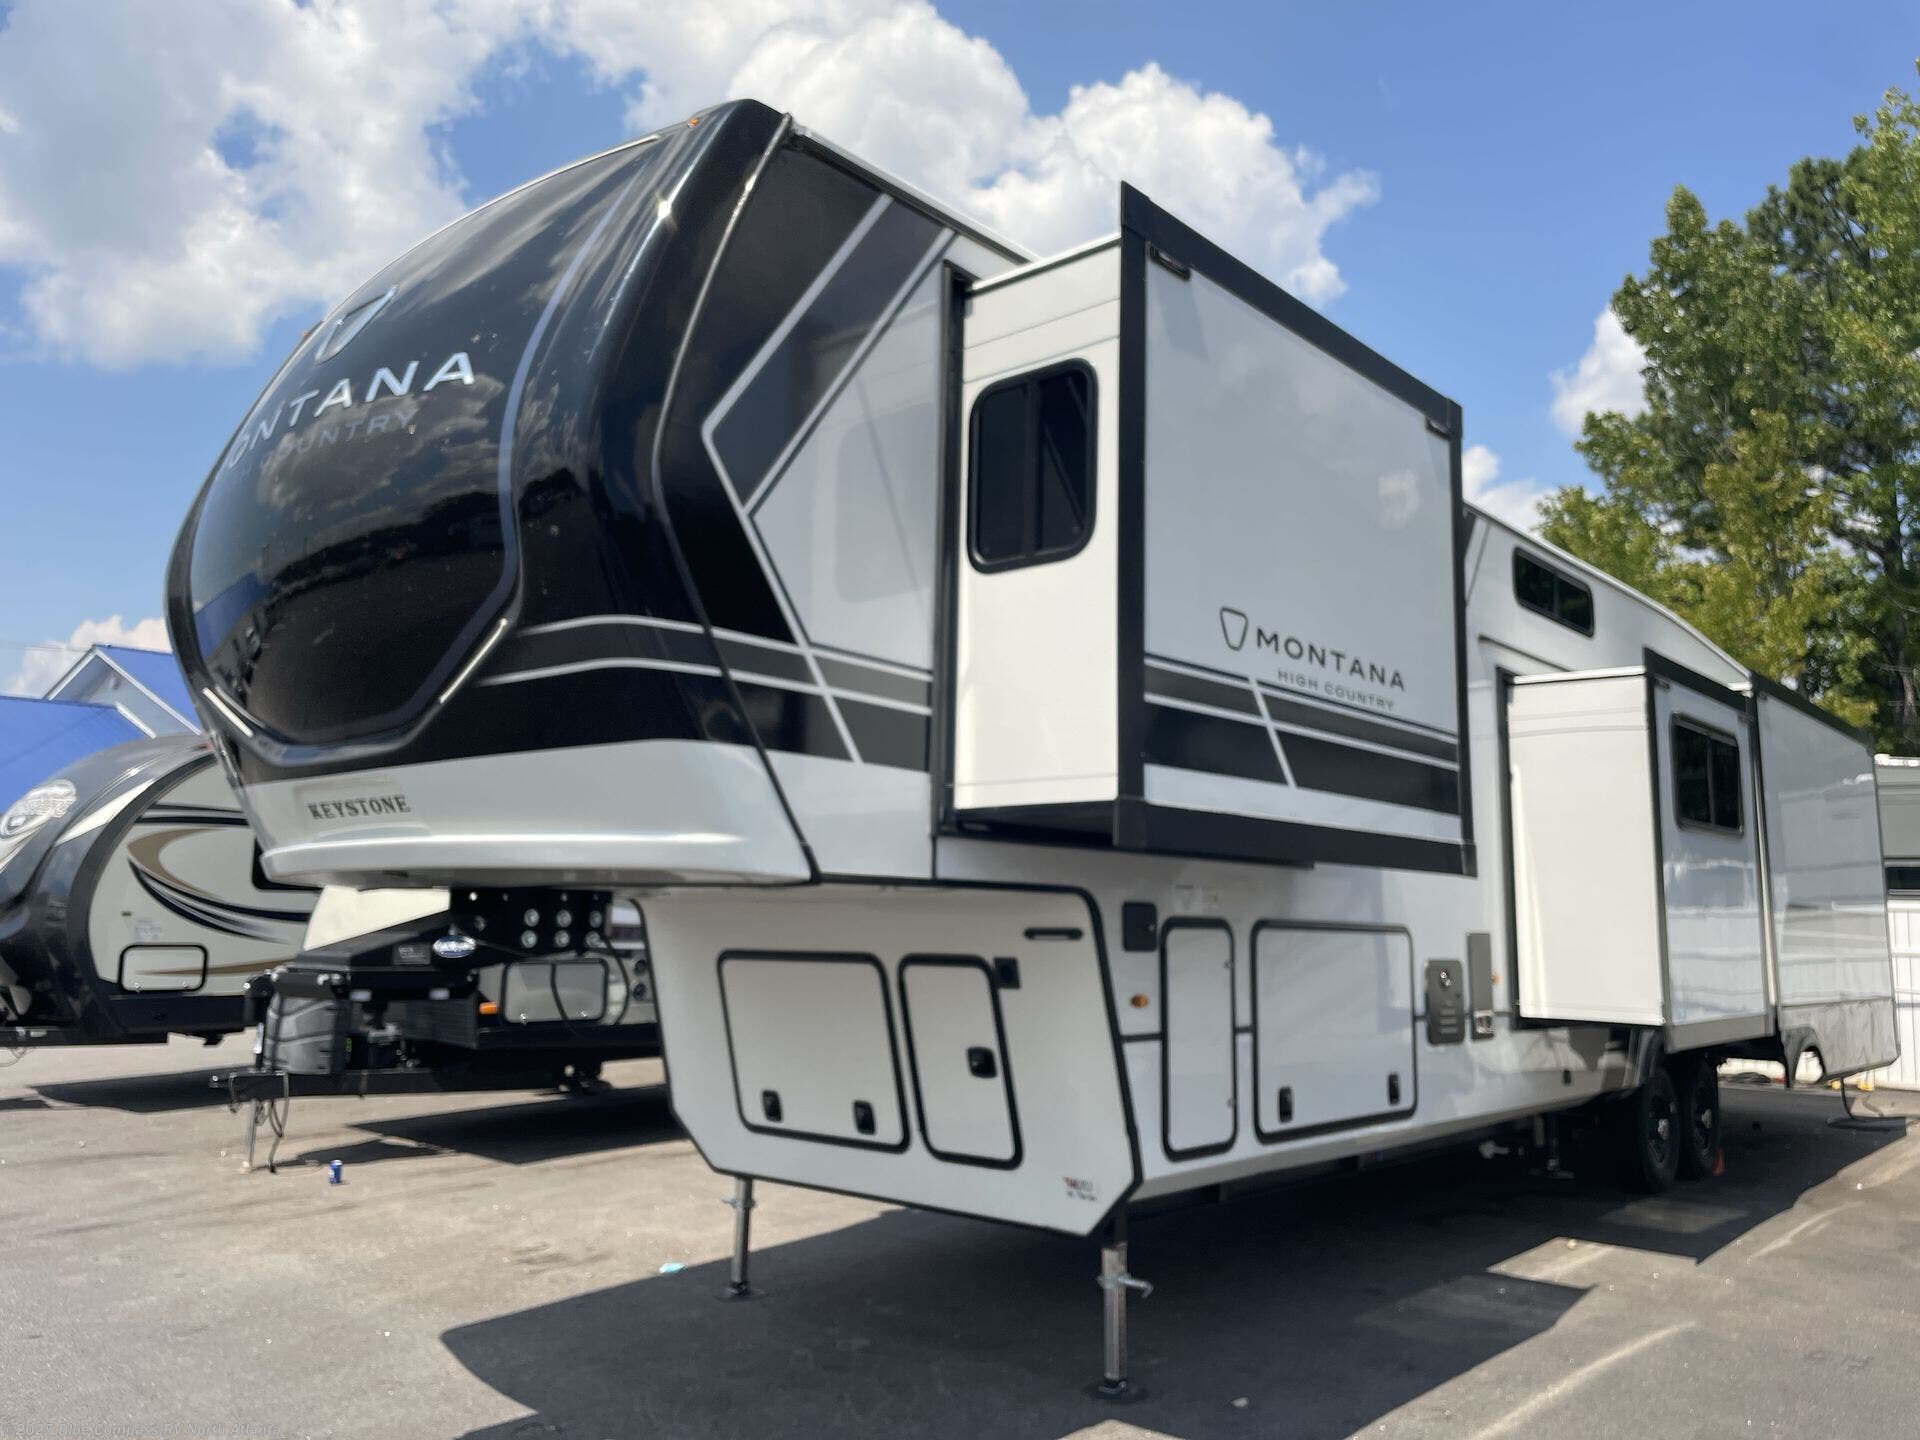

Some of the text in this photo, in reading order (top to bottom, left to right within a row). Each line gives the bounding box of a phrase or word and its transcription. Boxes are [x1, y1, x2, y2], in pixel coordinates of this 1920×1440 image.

[228, 351, 475, 468] ONTANA
[1256, 627, 1405, 692] MONTANA
[1277, 669, 1396, 710] HIGH COUNTRY
[307, 794, 411, 820] KEYSTONE
